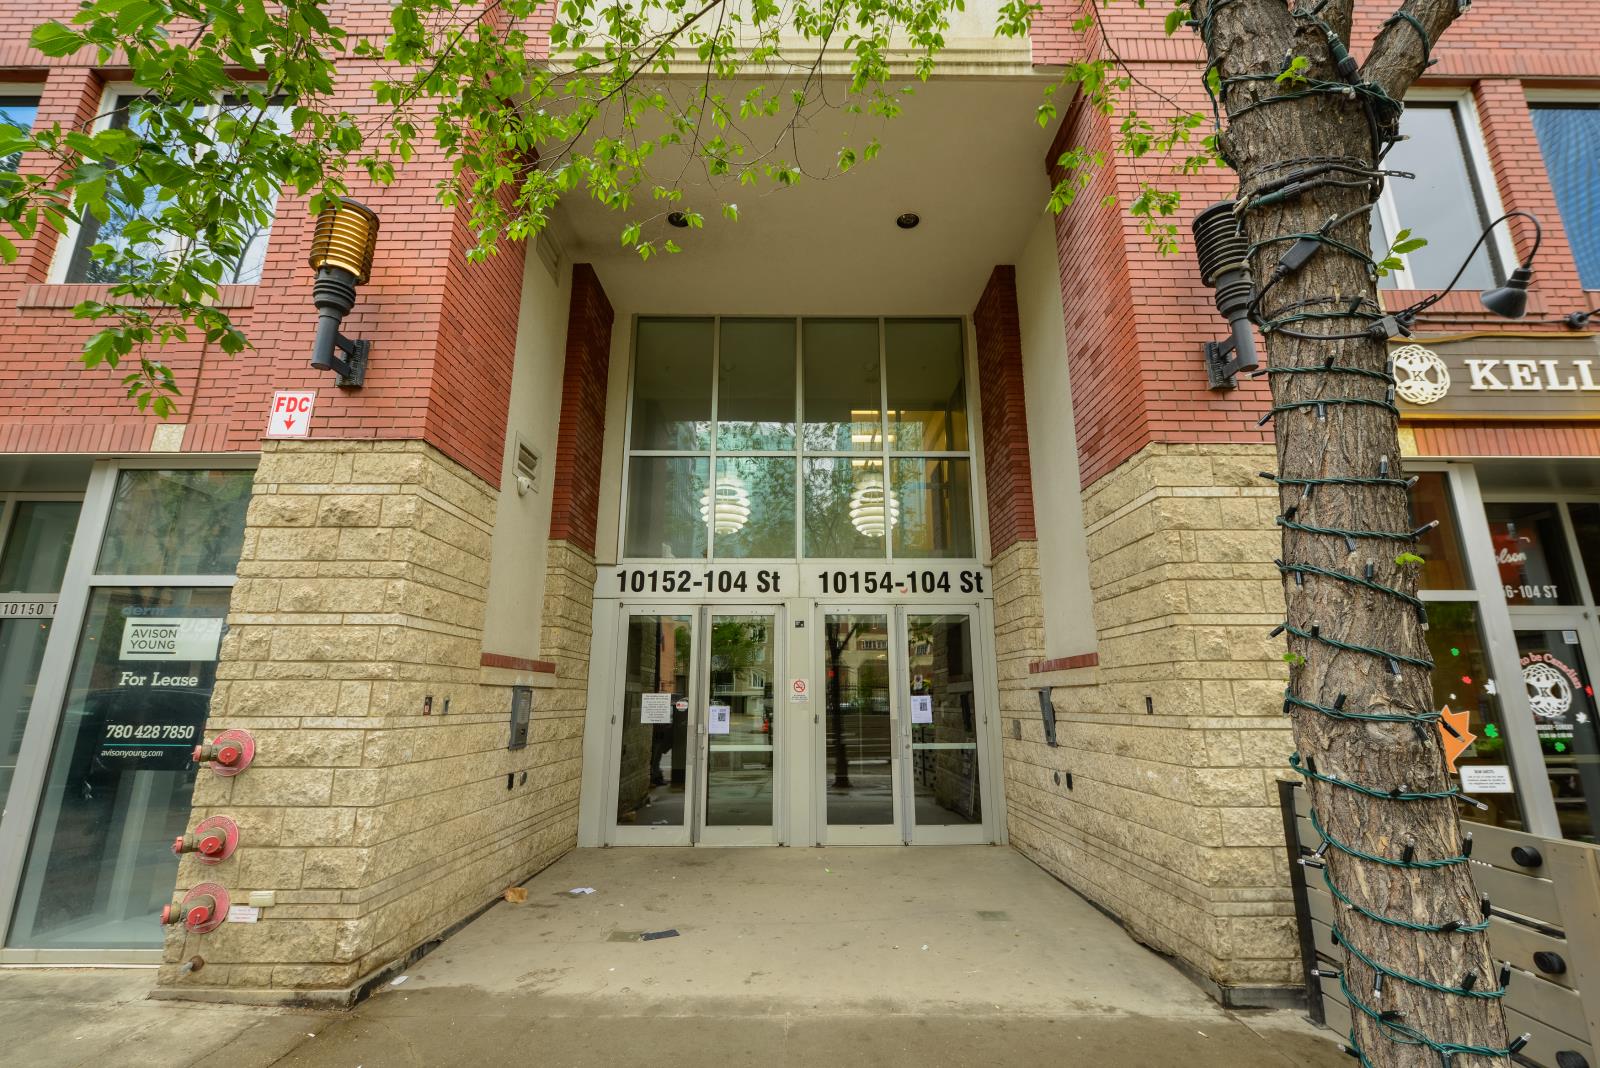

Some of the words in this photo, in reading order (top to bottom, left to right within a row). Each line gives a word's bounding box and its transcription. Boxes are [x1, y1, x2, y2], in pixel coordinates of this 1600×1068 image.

[1412, 370, 1425, 382] K
[1464, 359, 1600, 391] KELL
[275, 396, 310, 412] FDC
[617, 570, 747, 593] 10152-104
[757, 570, 781, 593] St
[818, 570, 951, 593] 10154-104
[960, 570, 984, 593] St
[1502, 585, 1541, 598] 6-104
[1542, 585, 1558, 598] ST
[4, 603, 44, 615] 10150
[131, 629, 178, 639] AVISON
[130, 640, 176, 650] YOUNG
[119, 671, 147, 686] For
[150, 671, 199, 687] Lease
[106, 724, 133, 738] 780
[134, 724, 161, 739] 428
[161, 725, 195, 739] 7850
[100, 749, 164, 759] avisonyoung.com
